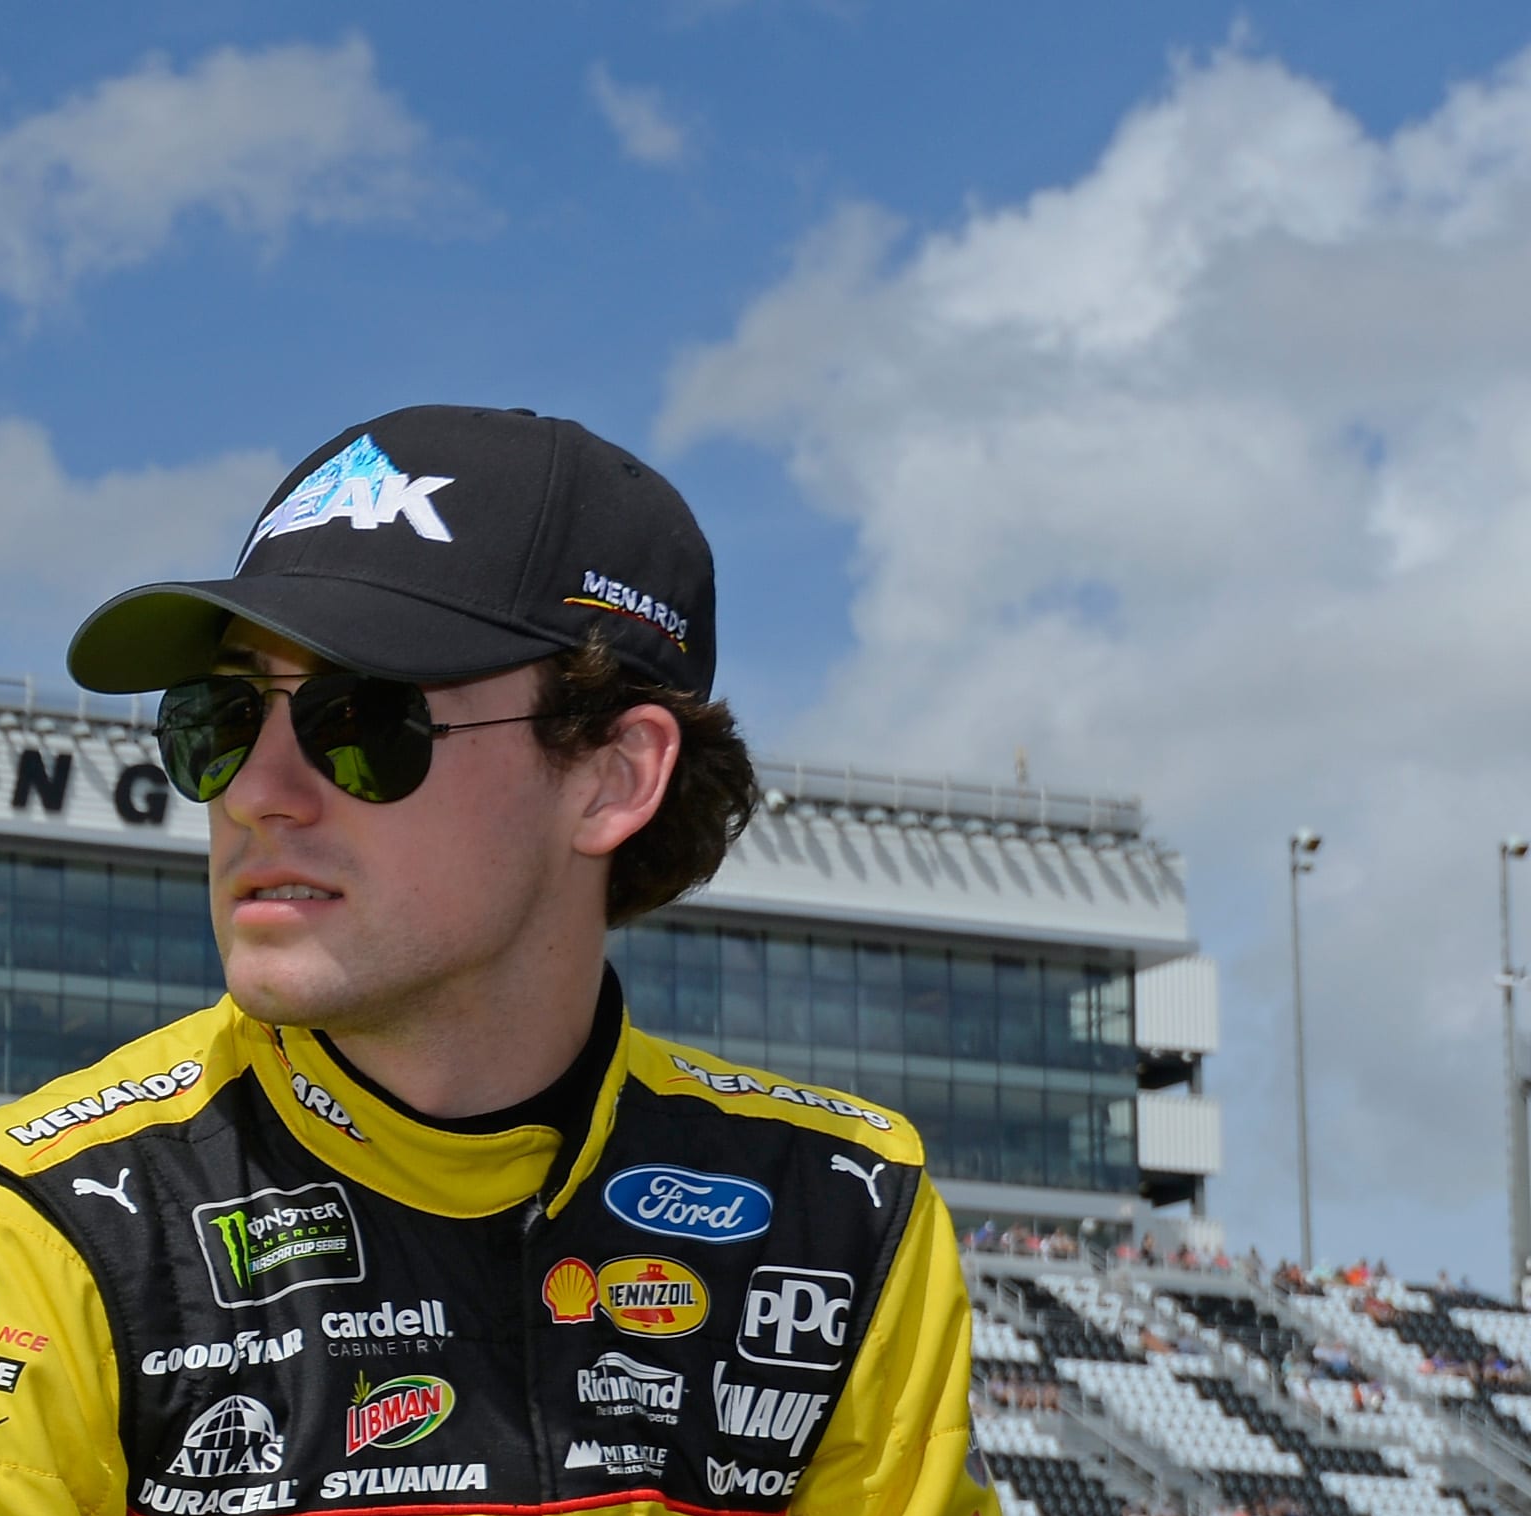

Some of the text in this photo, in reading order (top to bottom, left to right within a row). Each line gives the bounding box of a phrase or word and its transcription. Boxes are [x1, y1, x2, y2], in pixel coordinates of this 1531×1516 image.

[581, 569, 690, 640] MENARDS
[6, 1058, 204, 1148] MENARDS
[670, 1053, 891, 1131] MENARDS
[638, 1174, 745, 1230] Ford
[250, 1224, 332, 1254] ENERGY
[744, 1279, 851, 1354] PPG
[328, 1339, 445, 1358] CABINETRY
[345, 1383, 443, 1458] LIBMAN
[712, 1361, 831, 1458] KNAUF
[165, 1442, 284, 1478] ATLAS
[320, 1463, 487, 1499] SYLVANIA
[730, 1467, 807, 1496] MOE
[138, 1478, 297, 1516] DURACELL
